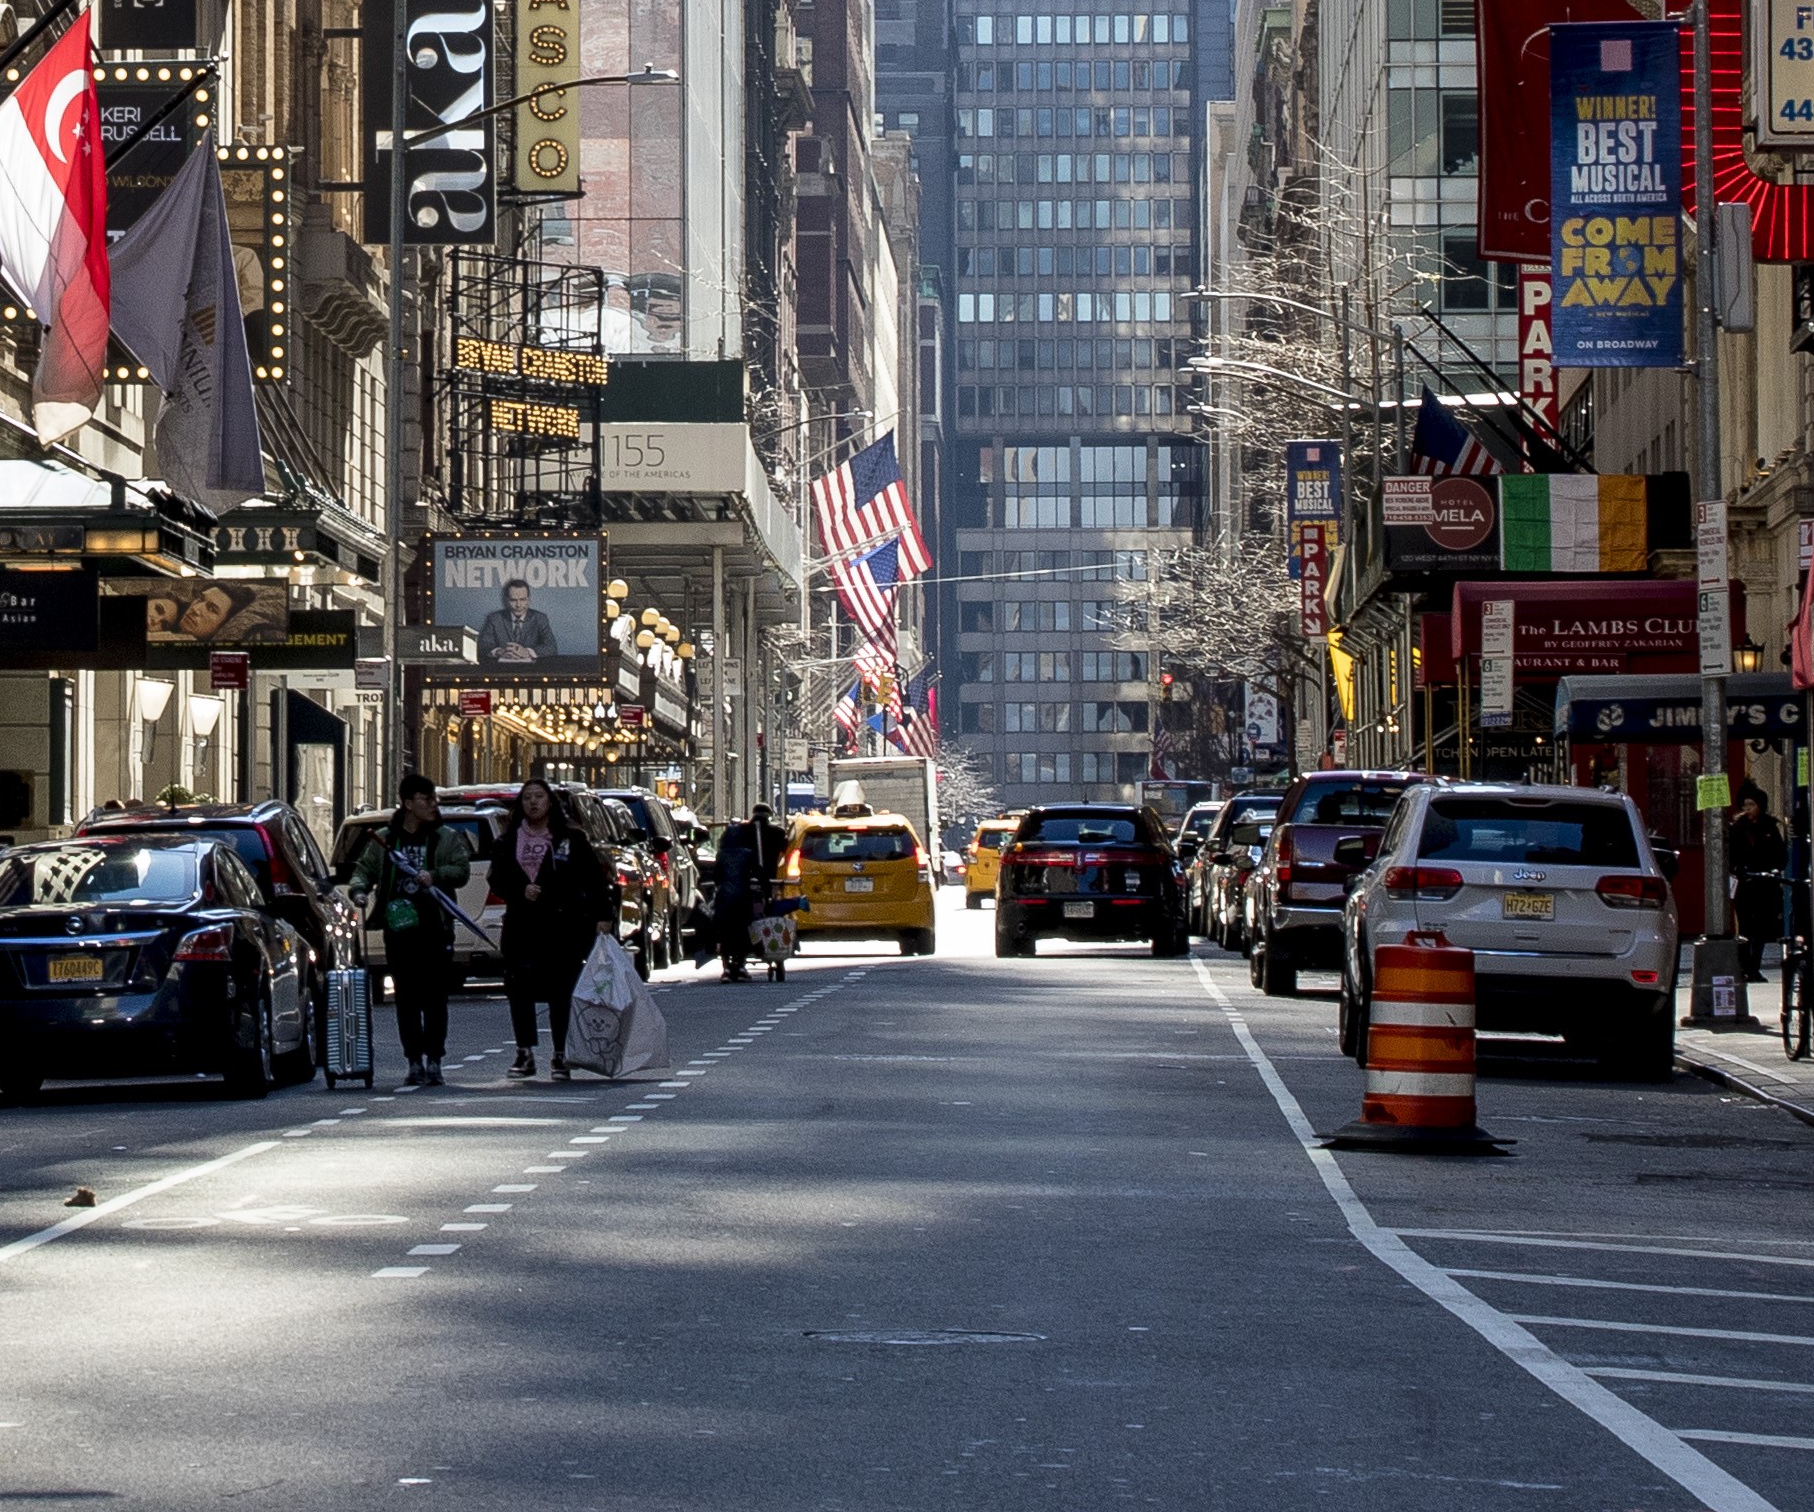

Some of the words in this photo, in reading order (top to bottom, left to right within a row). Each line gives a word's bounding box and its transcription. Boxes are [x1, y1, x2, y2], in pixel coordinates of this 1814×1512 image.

[101, 107, 141, 122] KERI
[1576, 96, 1657, 120] WINNER!
[1577, 120, 1657, 165] BEST
[1571, 164, 1666, 192] MUSICAL
[1571, 193, 1583, 203] ALL
[1584, 193, 1612, 203] ACROSS
[1613, 193, 1635, 202] NORTH
[1637, 192, 1667, 202] AMERICA
[1561, 216, 1676, 246] COME
[1560, 276, 1676, 307] AWAY
[1597, 340, 1659, 348] BROADWAY
[623, 471, 641, 479] THE
[644, 471, 690, 479] AMERICAS
[1297, 481, 1329, 498] BEST
[1386, 482, 1430, 493] DANGER
[1295, 499, 1334, 510] MUSICAL
[445, 546, 496, 558] BRYAN
[501, 545, 589, 558] CRANSTON
[445, 559, 589, 588] NETWORK
[1303, 543, 1321, 614] PARK
[11, 595, 36, 606] Bar
[2, 613, 37, 624] Asian
[1519, 625, 1546, 635] The
[1552, 619, 1638, 636] LAMBS
[1644, 617, 1700, 635] CLU
[284, 633, 347, 646] GEMENT
[419, 634, 459, 652] aka.
[1562, 640, 1621, 648] GEOFFREY
[1624, 639, 1683, 648] ZAKARIAN
[1514, 658, 1571, 667] AURANT
[1592, 658, 1619, 668] BAR
[1649, 704, 1766, 728] JIMY'S
[1521, 747, 1553, 757] LATE
[1512, 868, 1546, 882] Jeep
